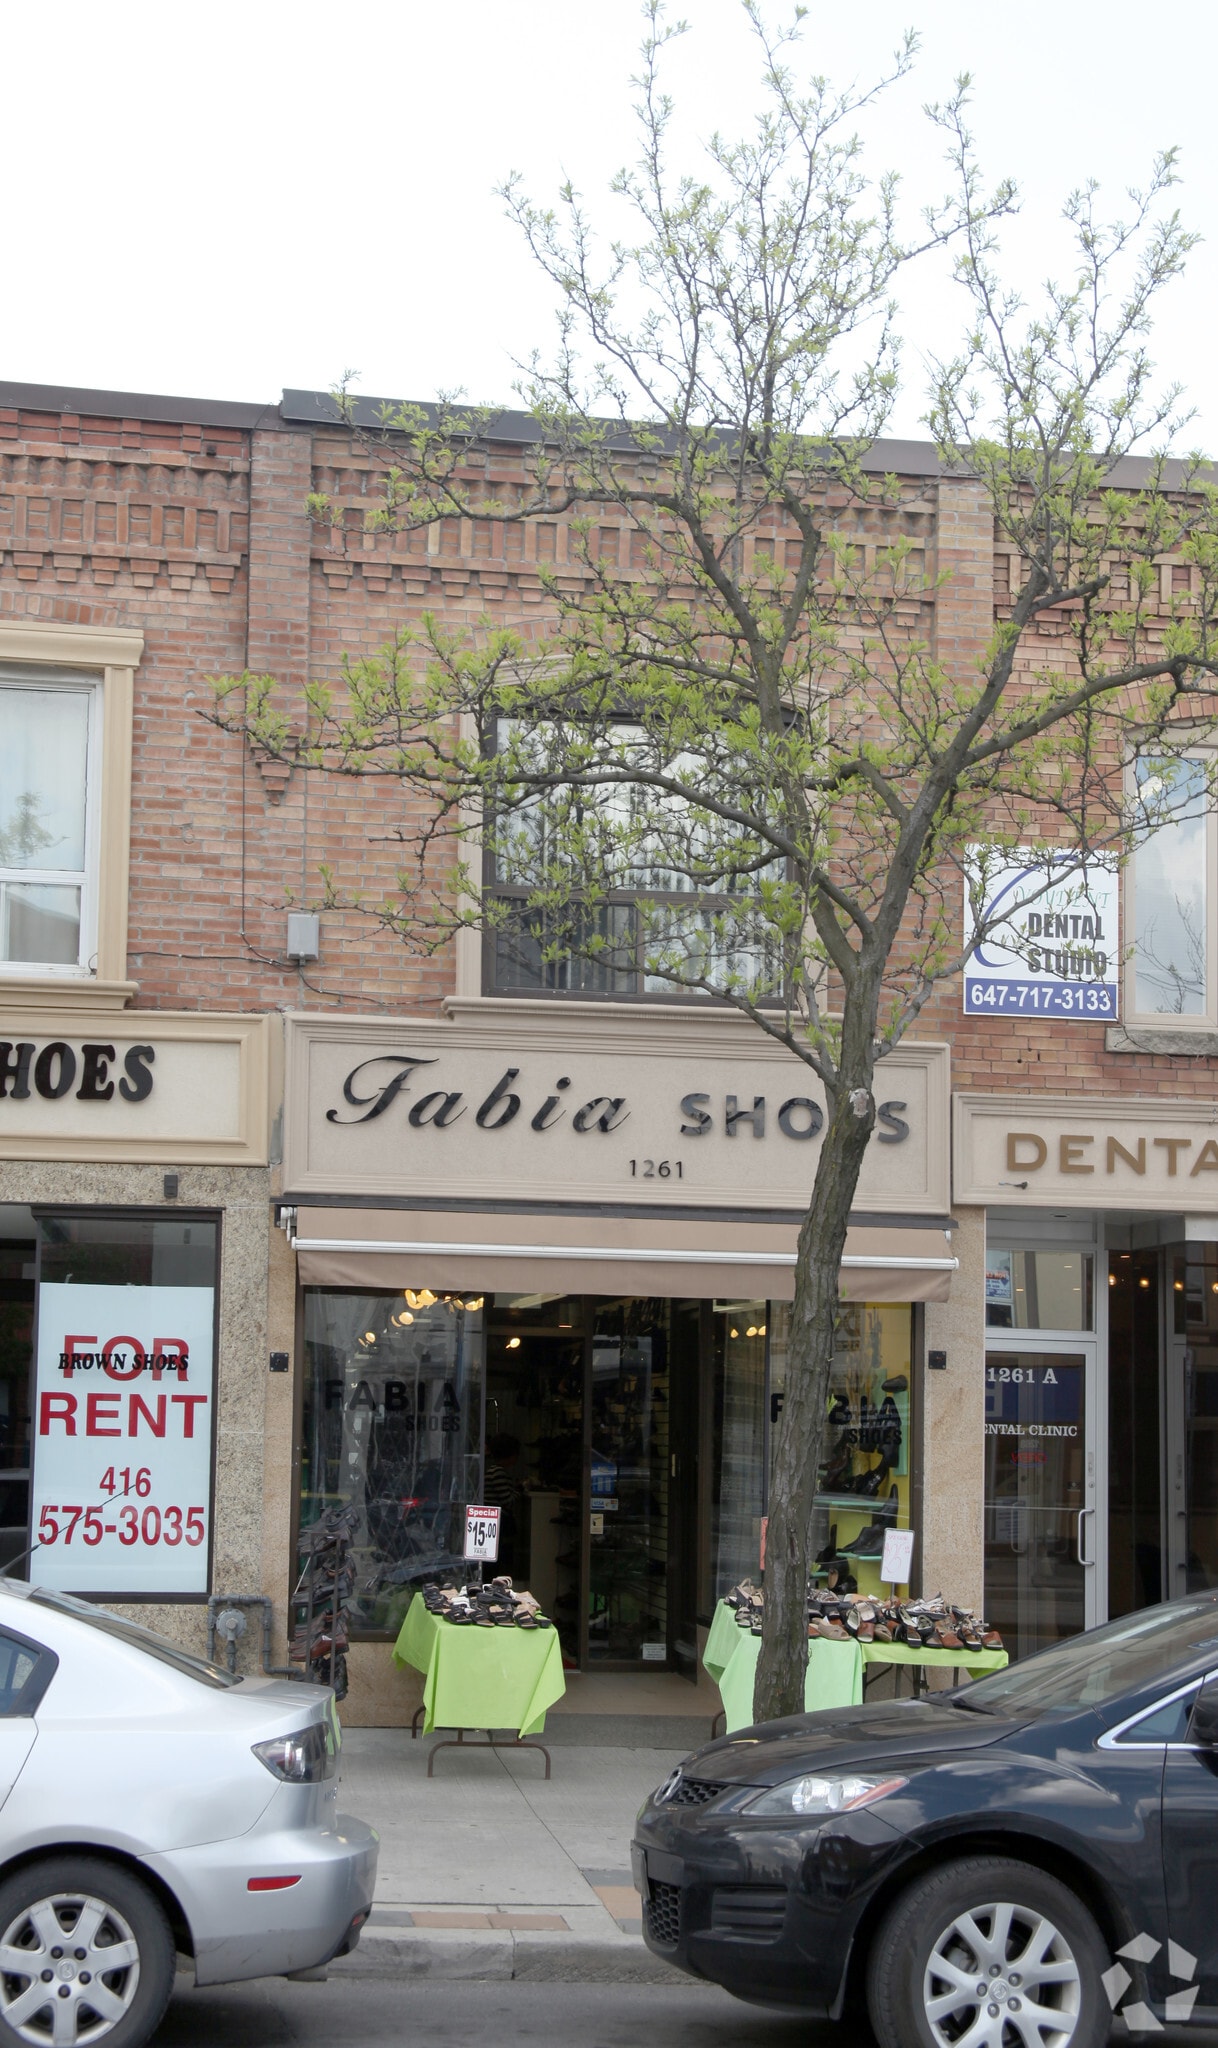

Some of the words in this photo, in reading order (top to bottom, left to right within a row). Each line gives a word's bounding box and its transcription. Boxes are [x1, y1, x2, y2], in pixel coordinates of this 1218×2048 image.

[1028, 912, 1105, 940] DENTAL
[1027, 947, 1108, 976] STUDIO
[971, 984, 1111, 1012] 647-717-3133
[326, 1055, 633, 1134] Fabia
[679, 1092, 911, 1145] SHOS
[628, 1158, 685, 1180] 1261
[58, 1352, 126, 1371] BROWN
[132, 1353, 189, 1371] SHOES
[62, 1334, 190, 1382] FOR
[987, 1367, 1036, 1384] 1261
[1042, 1367, 1059, 1384] A
[324, 1379, 461, 1412] FABIA
[770, 1392, 902, 1426] FBIA
[39, 1391, 208, 1439] RENT
[405, 1415, 461, 1432] SHOES
[848, 1428, 903, 1445] SHOES
[1028, 1424, 1078, 1437] CLINIC
[99, 1466, 152, 1497] 416
[38, 1504, 205, 1546] 575-3035
[468, 1508, 498, 1517] Special
